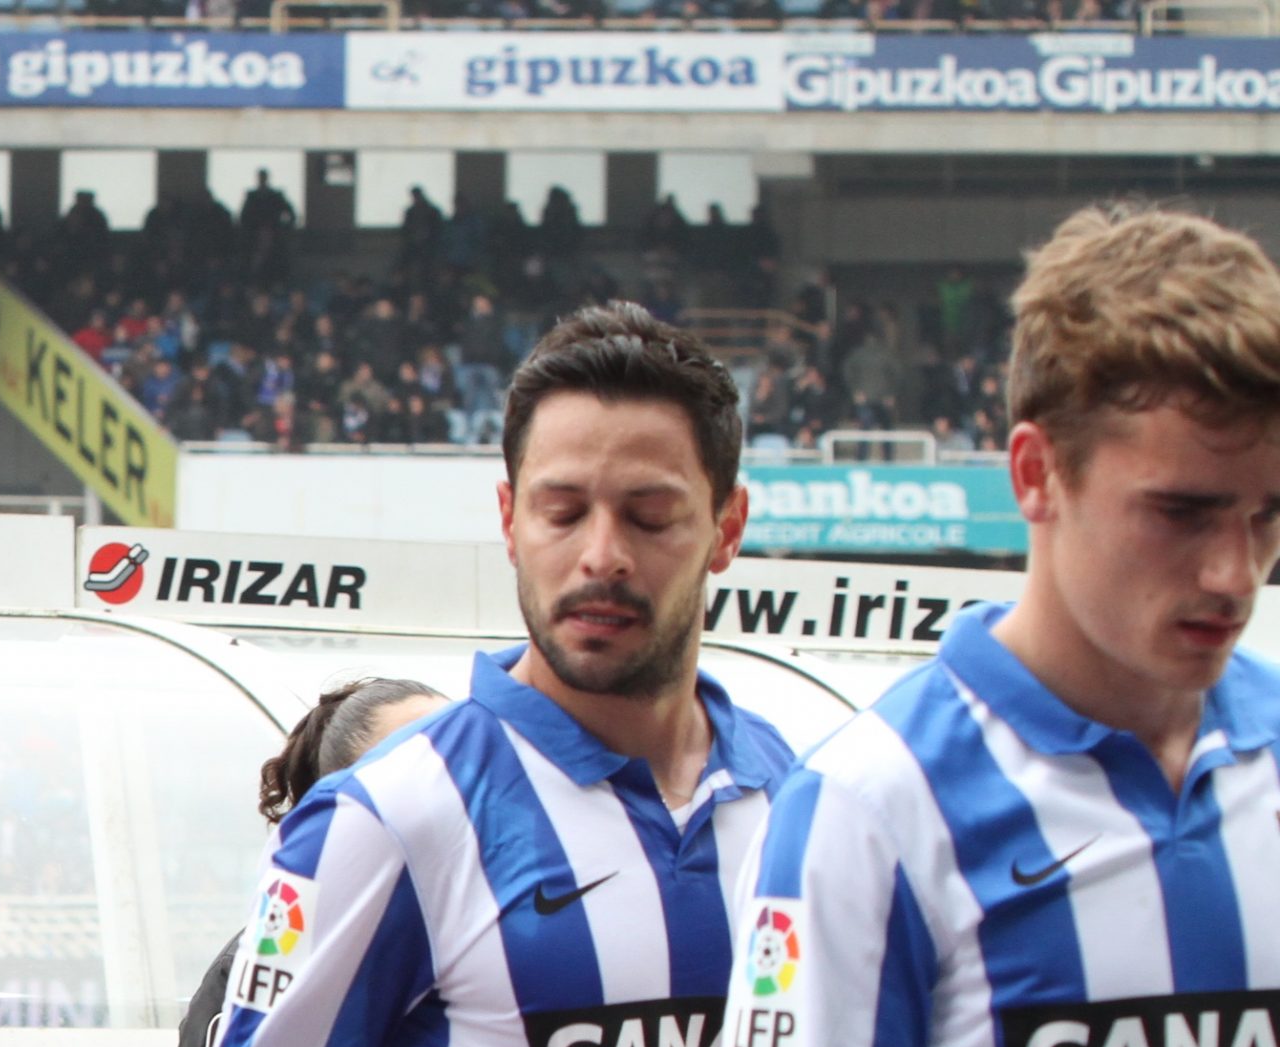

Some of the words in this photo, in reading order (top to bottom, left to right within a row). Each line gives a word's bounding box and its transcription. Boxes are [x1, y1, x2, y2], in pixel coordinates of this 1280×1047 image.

[7, 40, 305, 92] gipuzkoa
[464, 46, 758, 97] gipuzkoa
[786, 54, 1039, 109] Gipuzkoa
[26, 327, 149, 517] KELER
[156, 557, 366, 609] IRIZAR
[704, 577, 988, 641] w.iriz
[237, 960, 294, 1008] LFP
